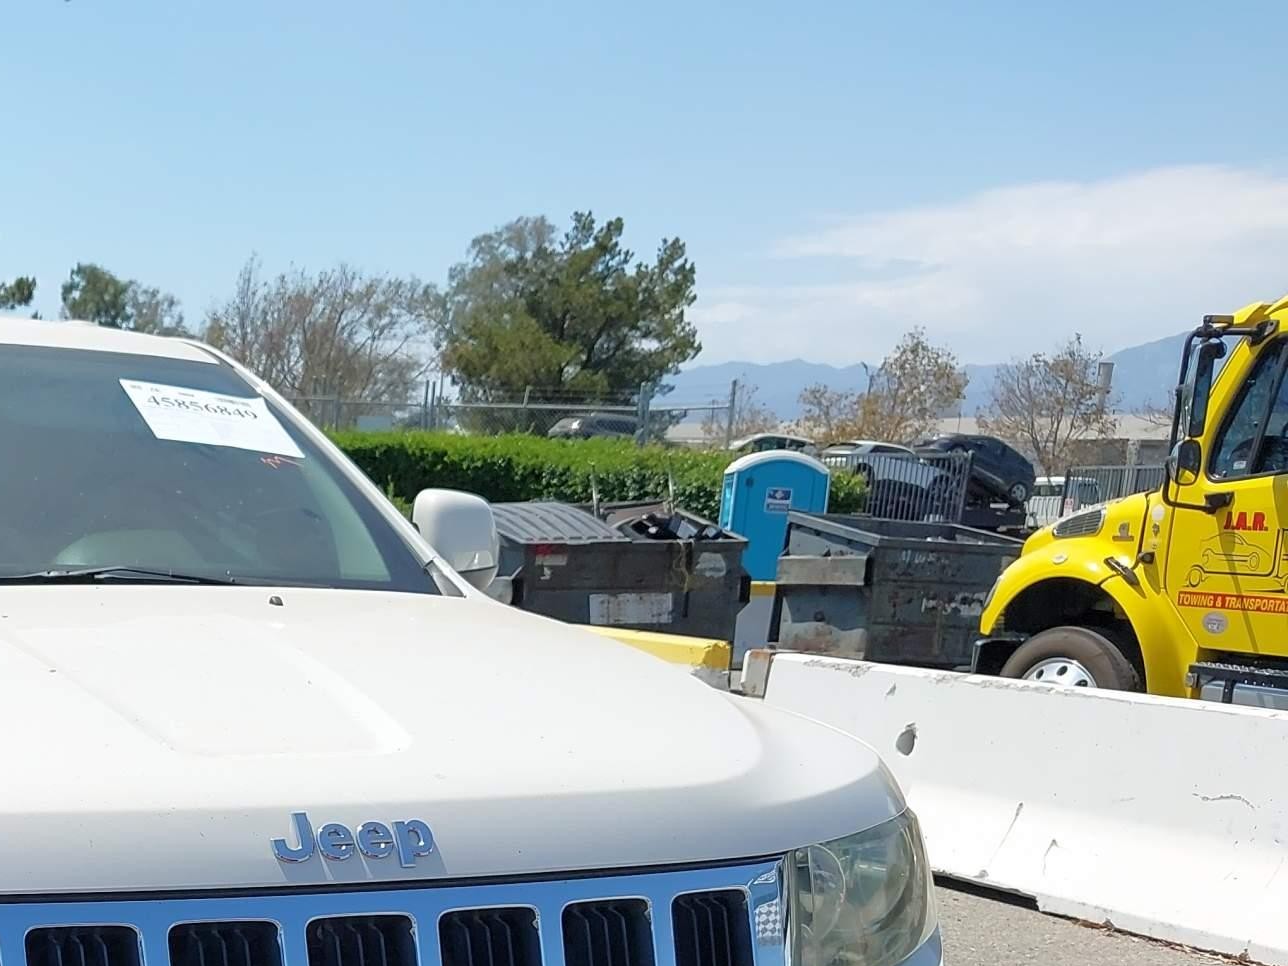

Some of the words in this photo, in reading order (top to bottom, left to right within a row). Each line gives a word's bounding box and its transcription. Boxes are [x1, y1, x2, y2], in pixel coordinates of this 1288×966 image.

[1223, 511, 1268, 531] J.A.R.
[1179, 593, 1214, 608] TOWING
[1215, 596, 1222, 608] &
[270, 811, 434, 868] Jeep
